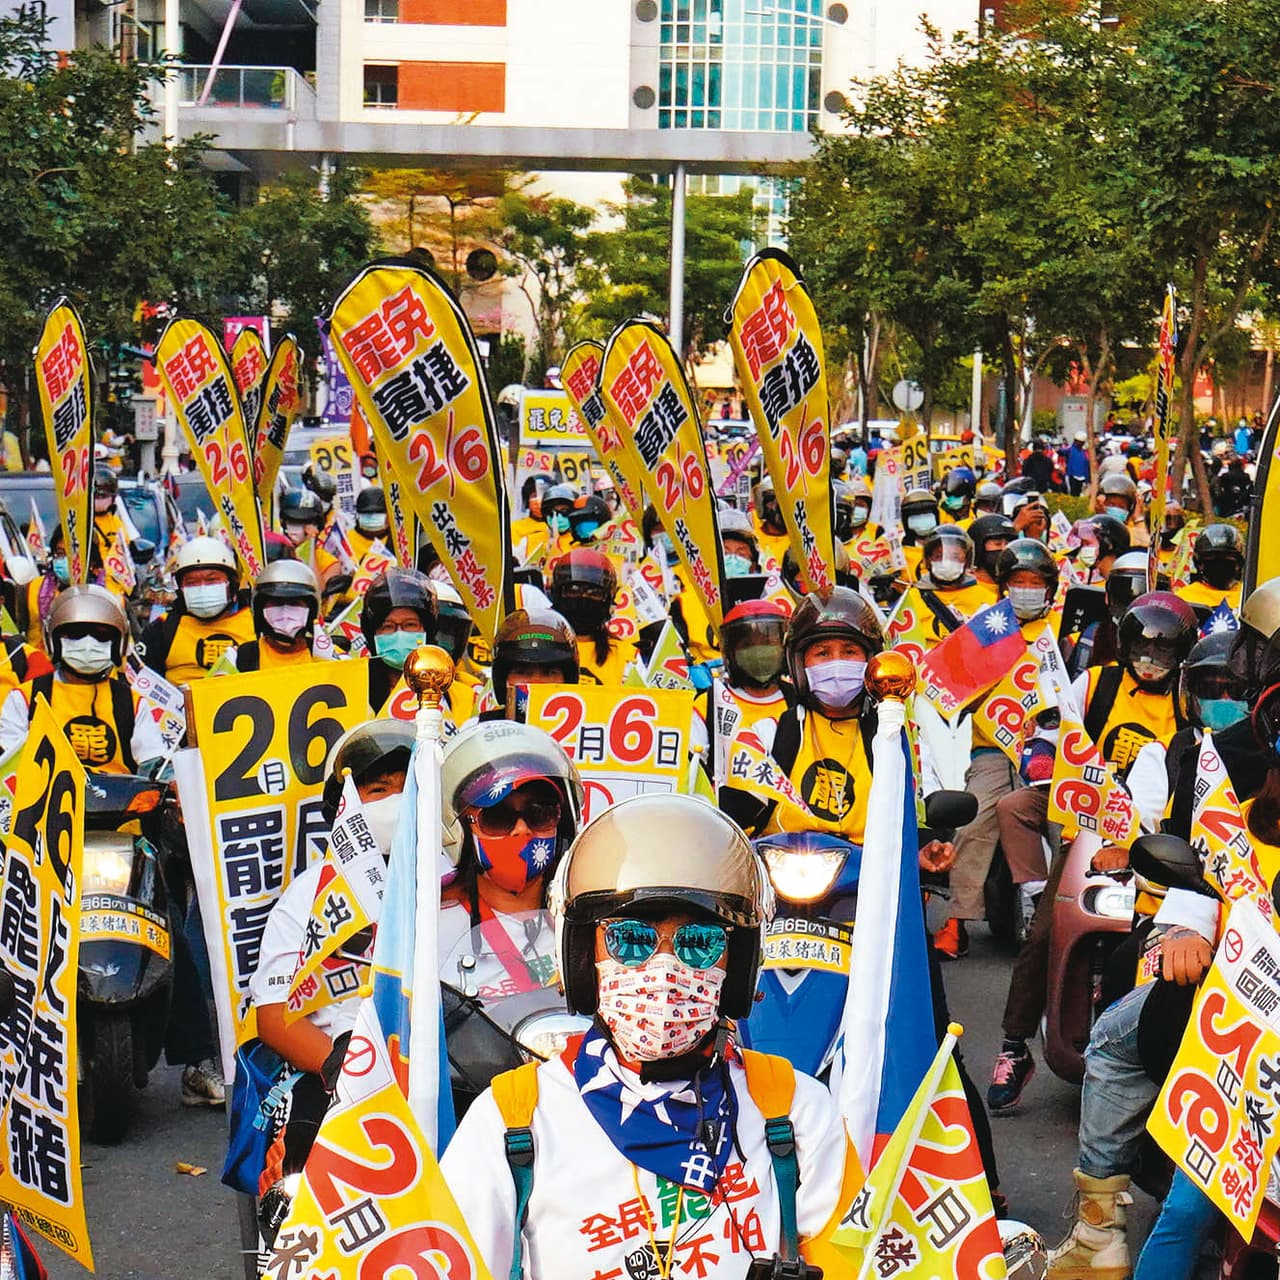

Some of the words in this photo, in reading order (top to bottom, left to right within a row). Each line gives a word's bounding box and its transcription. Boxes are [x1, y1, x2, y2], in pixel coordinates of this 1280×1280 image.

[41, 323, 82, 404] 罷免
[164, 334, 218, 403] 罷免
[341, 284, 435, 385] 罷免
[739, 277, 795, 383] 罷免
[184, 375, 234, 445] 黃捷
[372, 340, 469, 441] 黃捷
[609, 340, 664, 427] 罷免
[633, 382, 688, 471] 黃捷
[759, 331, 820, 439] 黃捷
[204, 426, 250, 493] 2/6
[409, 408, 489, 498] 2/6
[656, 441, 704, 516] 2/6
[780, 400, 827, 496] 2/6
[431, 502, 495, 609] 出來投票
[69, 724, 110, 764] 罷
[542, 695, 680, 767] 2月6日
[810, 765, 850, 815] 罷
